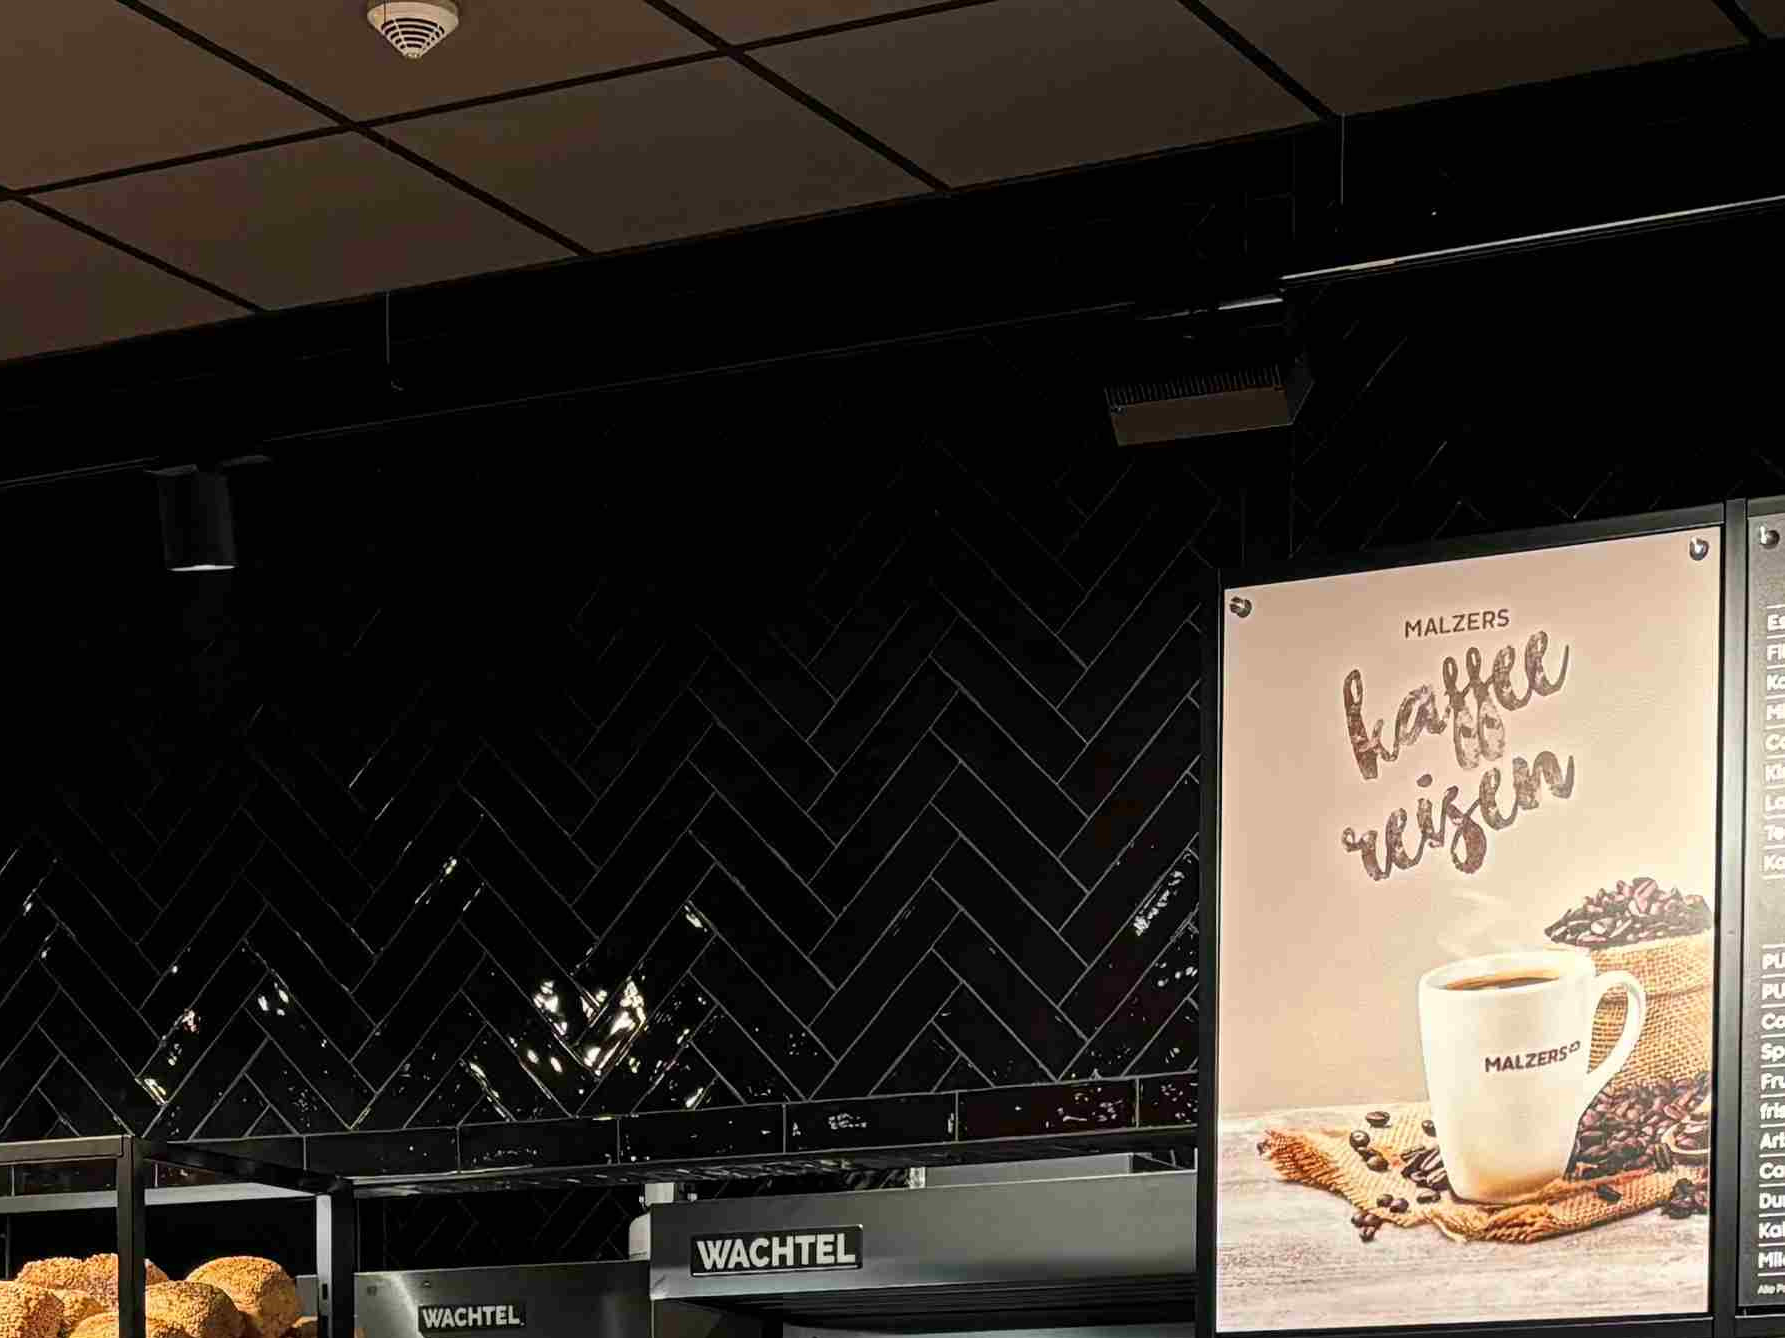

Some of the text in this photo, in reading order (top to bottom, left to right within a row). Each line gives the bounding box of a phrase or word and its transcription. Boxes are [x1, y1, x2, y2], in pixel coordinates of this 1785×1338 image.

[1404, 608, 1510, 639] MALZERS
[1342, 630, 1570, 779] kaffee
[1340, 750, 1575, 881] reisen
[1484, 1045, 1568, 1073] MALZERS
[696, 1232, 857, 1272] WACHTEL
[421, 1305, 521, 1329] WACHTEL
